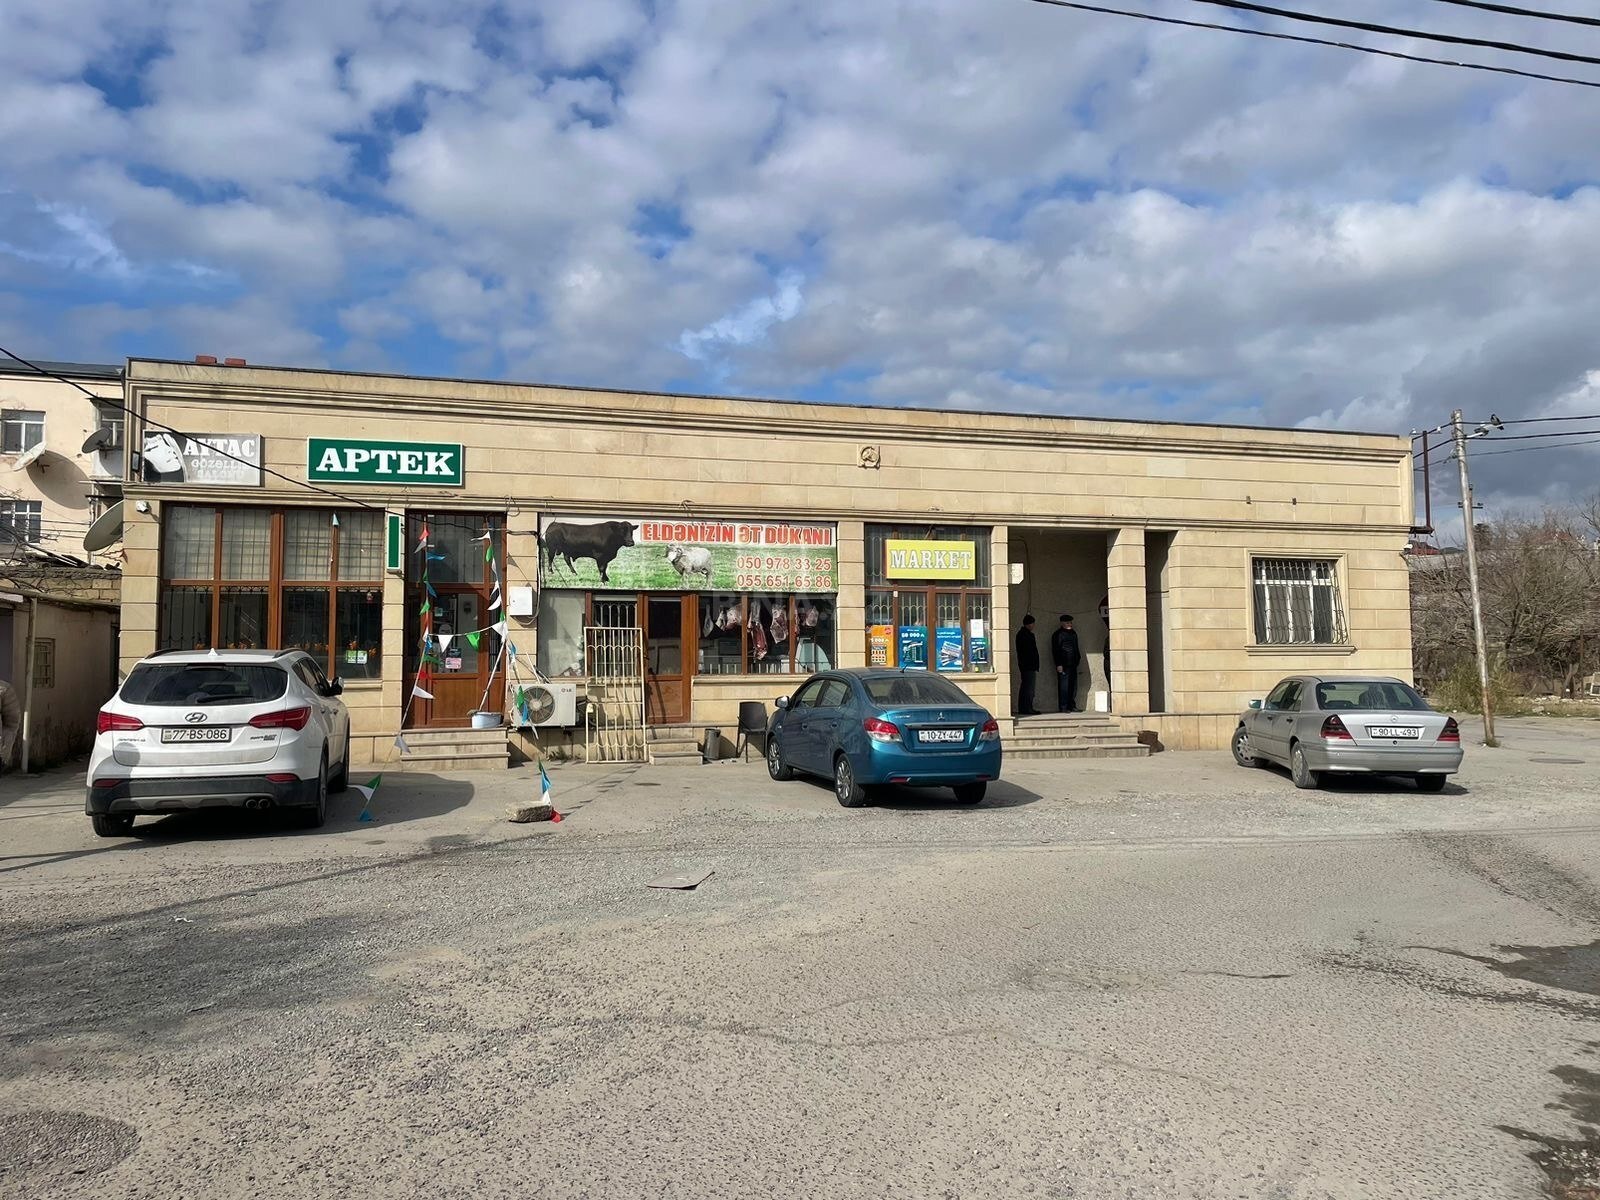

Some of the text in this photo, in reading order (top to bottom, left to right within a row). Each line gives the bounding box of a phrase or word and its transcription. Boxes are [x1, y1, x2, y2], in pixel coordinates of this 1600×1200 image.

[315, 447, 455, 476] APTEK
[642, 522, 832, 545] ELDƏNİZİN ƏT DÜKANI
[736, 556, 832, 572] 050 978 33 25
[889, 549, 972, 570] MARKET
[736, 574, 832, 588] 055 651 65 86
[172, 729, 227, 740] 77-BS-086
[1378, 728, 1417, 737] 90-LL-493
